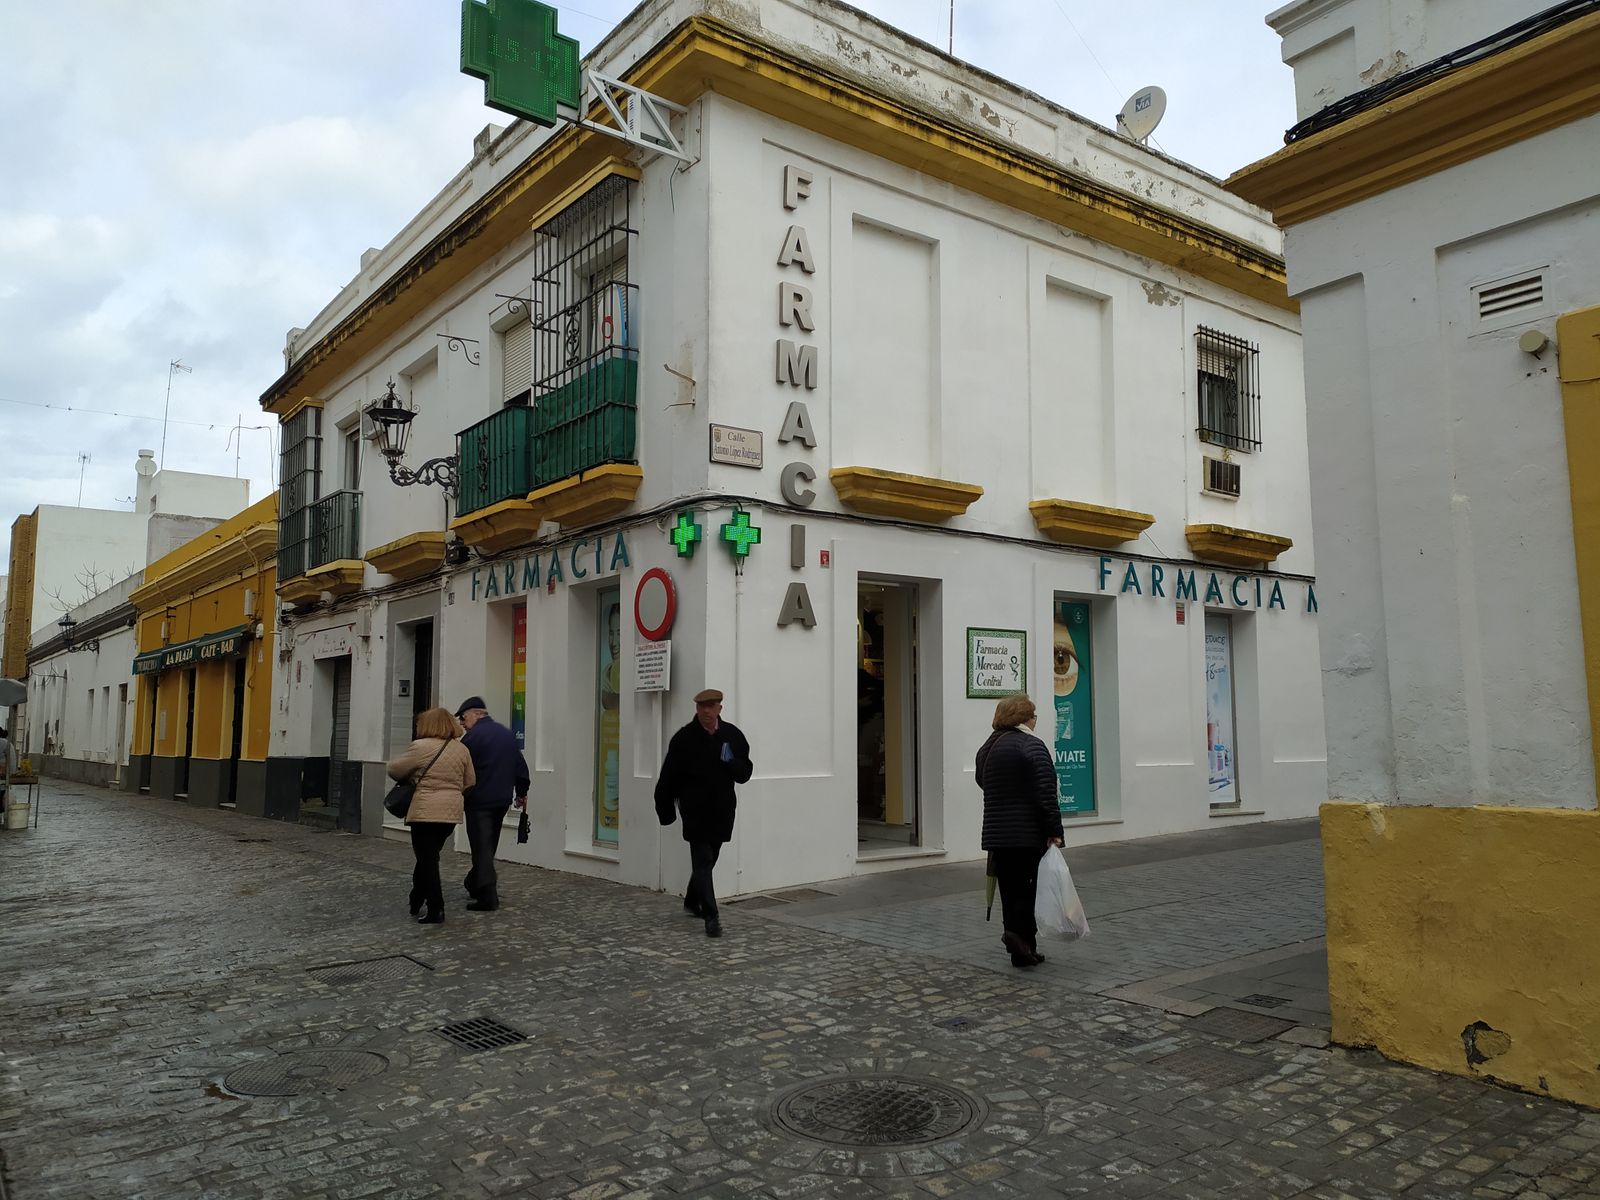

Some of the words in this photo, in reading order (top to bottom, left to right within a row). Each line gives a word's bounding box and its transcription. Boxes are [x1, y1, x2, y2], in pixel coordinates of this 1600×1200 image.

[777, 164, 817, 628] FARMACIA
[727, 431, 746, 443] Calle
[471, 529, 630, 601] FARMACIA
[1099, 556, 1286, 610] FARMACIA
[976, 639, 1008, 655] Farmacia
[975, 655, 1006, 671] Mercado
[976, 672, 1003, 687] Central
